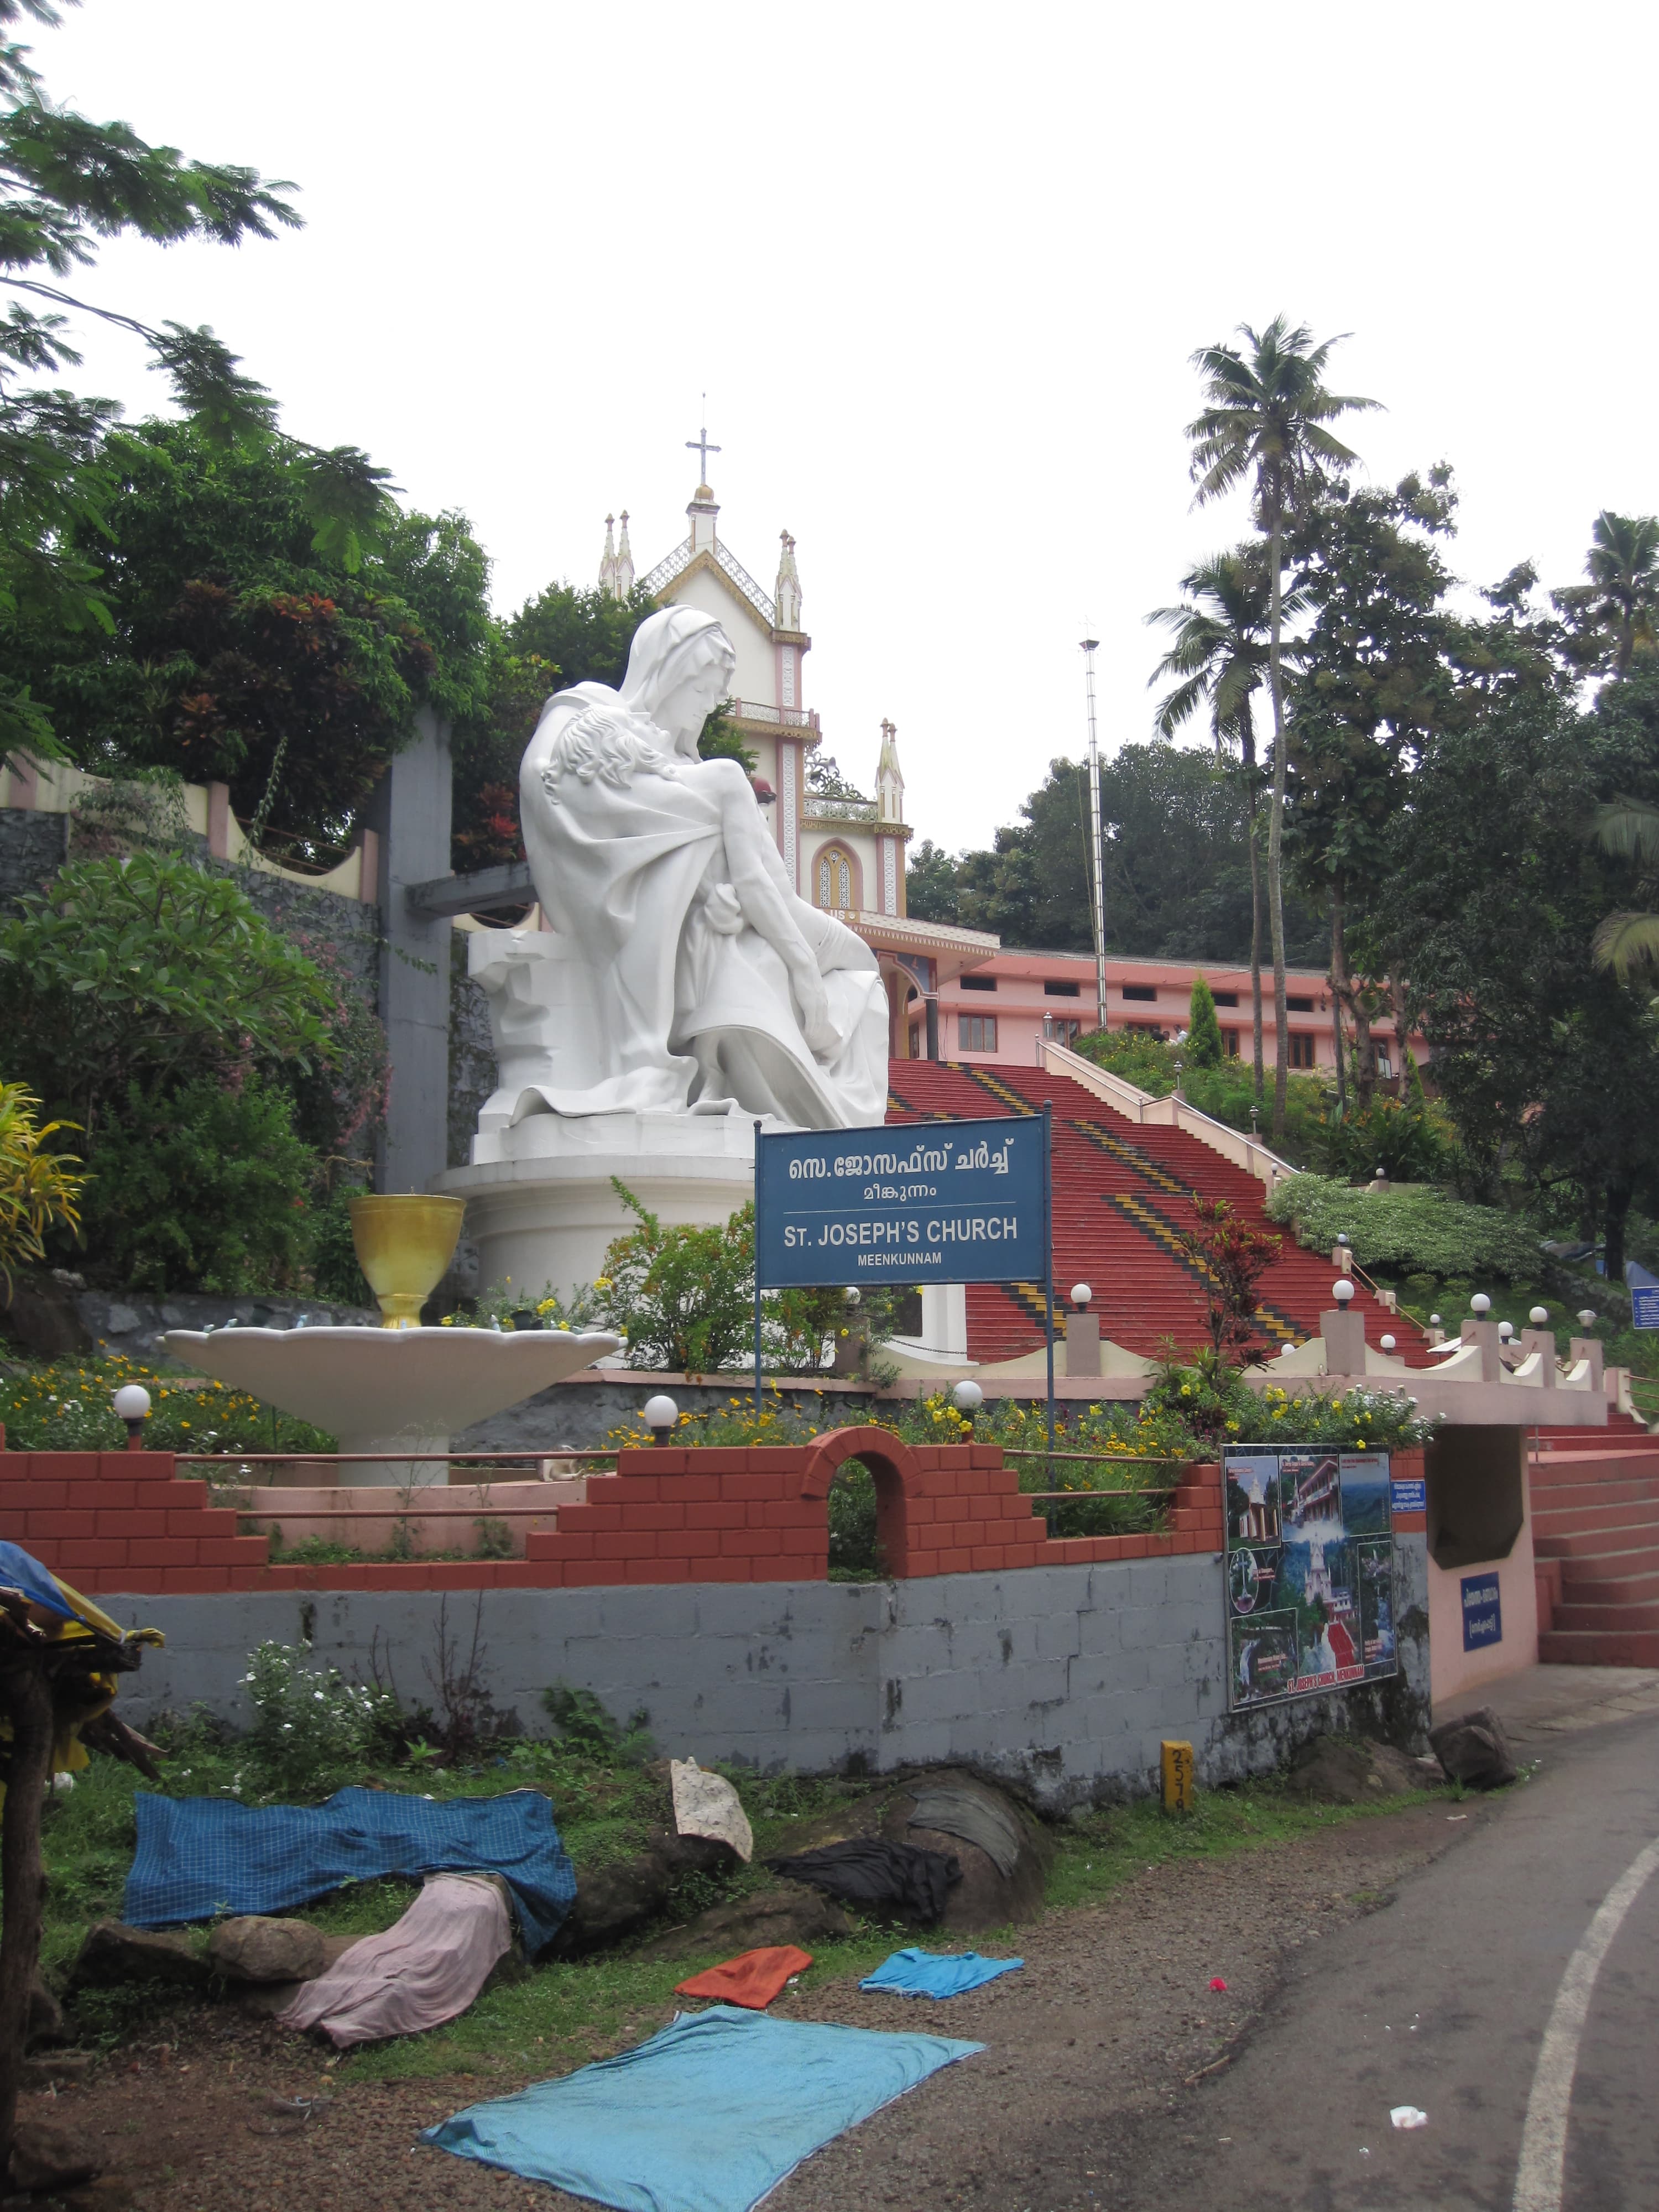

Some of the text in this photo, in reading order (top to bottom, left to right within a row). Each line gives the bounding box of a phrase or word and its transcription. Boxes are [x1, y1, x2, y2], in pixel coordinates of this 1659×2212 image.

[864, 1183, 936, 1202] മീങ്കുന്നം
[784, 1217, 1017, 1247] ST. JOSEPH'S CHURCH
[858, 1252, 942, 1266] MEENKUNNAM
